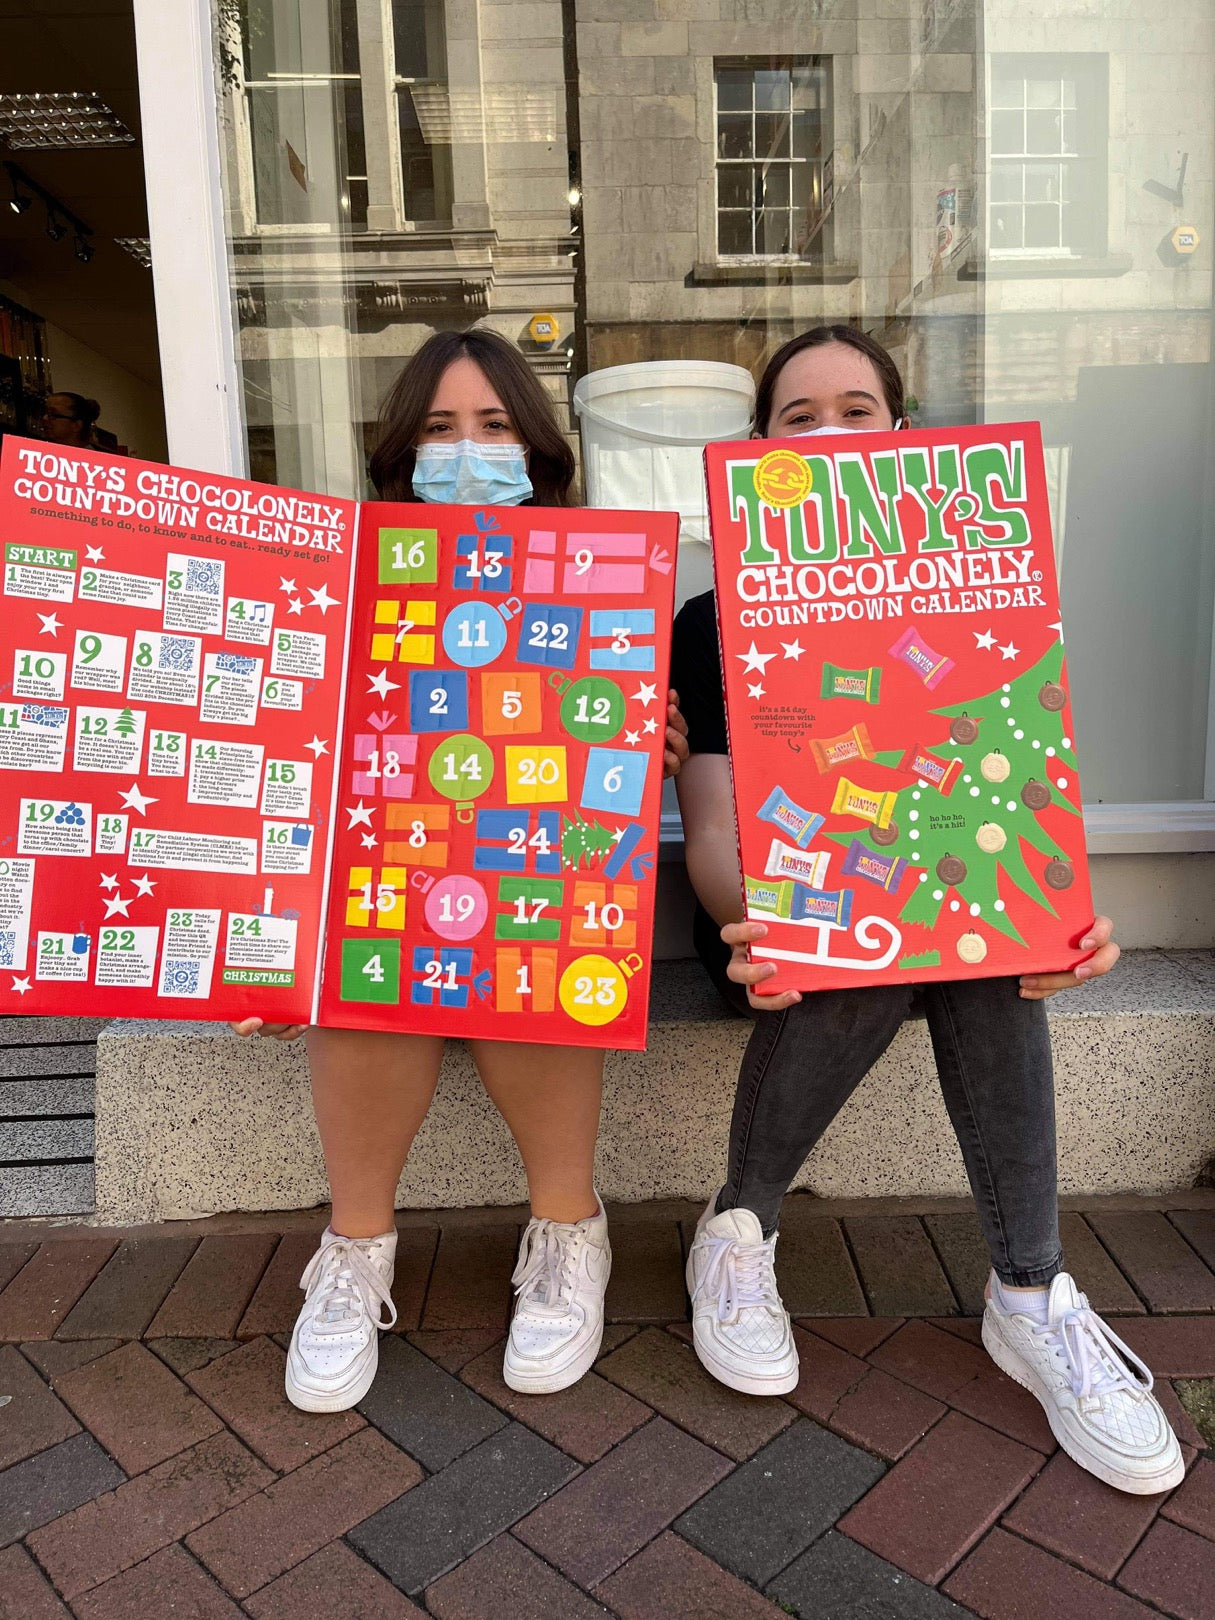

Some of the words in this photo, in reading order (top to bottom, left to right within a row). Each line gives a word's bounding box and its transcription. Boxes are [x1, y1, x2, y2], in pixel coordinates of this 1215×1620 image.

[18, 449, 125, 491] TONY'S
[136, 470, 343, 530] CHOCOLONELY
[725, 440, 1032, 565] TONY'S
[14, 478, 198, 528] COUNTDOWN
[206, 512, 344, 554] CALENDAR
[30, 504, 98, 528] something
[101, 517, 115, 529] to
[116, 518, 136, 534] do,
[138, 522, 151, 534] to
[153, 525, 187, 541] know
[190, 530, 213, 544] and
[215, 533, 227, 546] to
[257, 540, 292, 560] ready
[294, 546, 310, 560] set
[312, 550, 330, 564] go!
[8, 548, 73, 568] START
[391, 540, 425, 569] 16
[466, 551, 504, 578] 13
[574, 549, 593, 576] 9
[8, 567, 17, 581] 1
[82, 571, 97, 591] 2
[168, 571, 183, 589] 3
[736, 550, 1036, 603] CHOCOLONELY
[230, 601, 246, 620] 4
[740, 596, 903, 628] COUNTDOWN
[910, 585, 1046, 615] CALENDAR
[278, 633, 291, 651] 5
[395, 619, 414, 643] 7
[457, 620, 489, 647] 11
[528, 620, 569, 650] 22
[611, 628, 631, 654] 3
[80, 635, 102, 664] 9
[136, 642, 152, 667] 8
[19, 655, 55, 678] 10
[205, 675, 220, 692] 7
[266, 681, 278, 699] 6
[429, 688, 448, 714] 2
[501, 691, 523, 718] 5
[574, 695, 611, 725] 12
[81, 716, 108, 736] 12
[780, 729, 804, 737] tony's
[154, 733, 181, 752] 13
[195, 744, 217, 759] 14
[267, 762, 295, 783] 15
[366, 750, 401, 778] 18
[442, 753, 482, 781] 14
[517, 758, 559, 785] 20
[603, 765, 624, 793] 6
[26, 803, 54, 822] 19
[102, 818, 122, 834] 18
[133, 832, 156, 847] 17
[267, 828, 288, 844] 16
[408, 820, 427, 848] 8
[507, 828, 551, 855] 24
[358, 882, 396, 912] 15
[438, 894, 476, 922] 19
[513, 896, 549, 924] 17
[170, 913, 193, 927] 23
[232, 918, 262, 936] 24
[583, 901, 624, 930] 10
[41, 938, 64, 954] 21
[102, 930, 135, 951] 22
[224, 970, 292, 983] CHRISTMAS
[362, 954, 385, 982] 4
[422, 960, 459, 990] 21
[516, 965, 531, 994] 1
[574, 976, 617, 1005] 23
